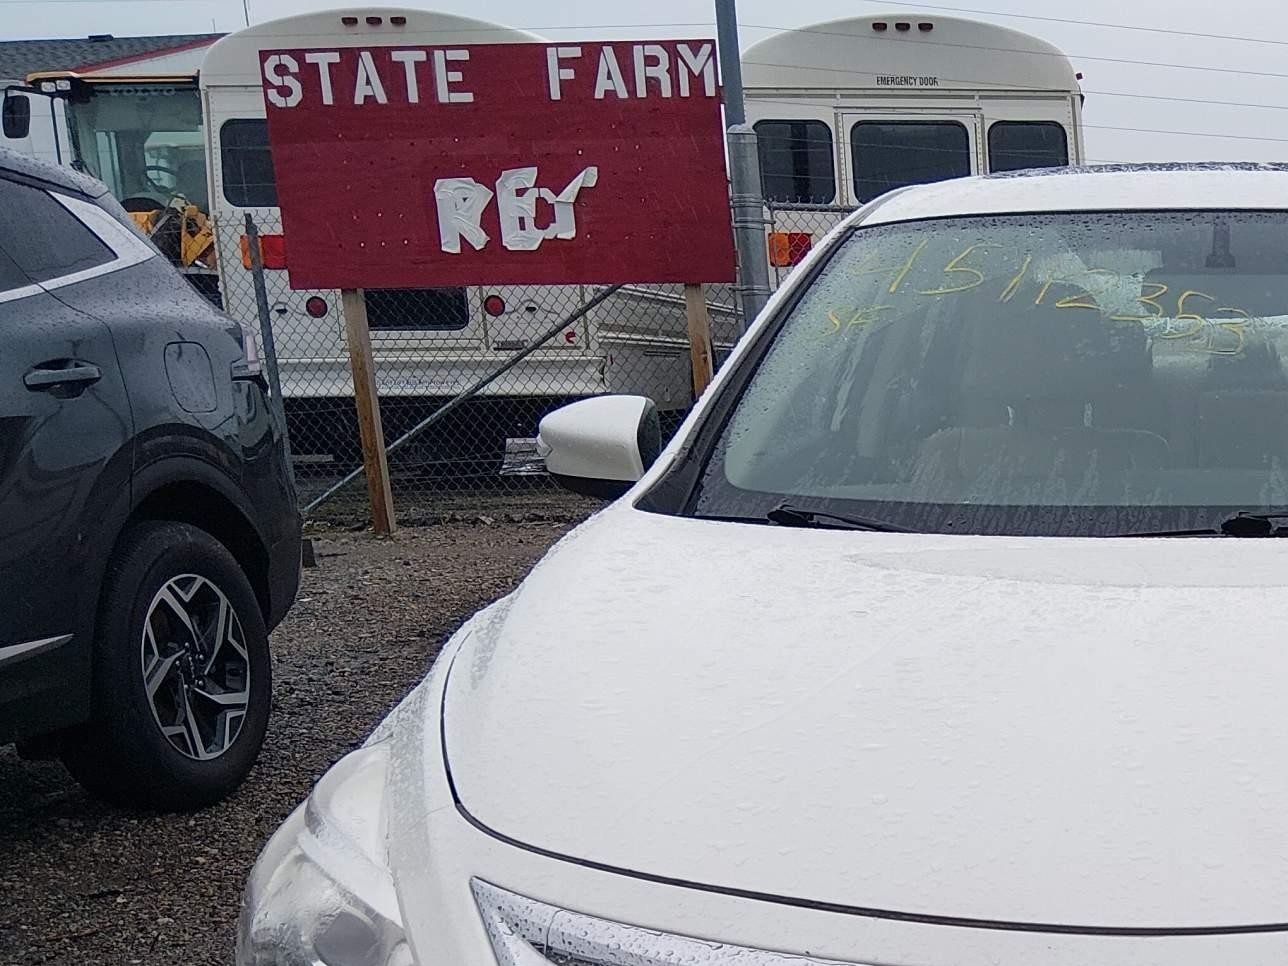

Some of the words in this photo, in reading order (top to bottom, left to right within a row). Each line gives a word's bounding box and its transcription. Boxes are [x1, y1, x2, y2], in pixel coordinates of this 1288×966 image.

[263, 49, 475, 108] STATE
[546, 42, 717, 100] FARM
[876, 76, 917, 86] EMERGENCY
[919, 76, 939, 87] DOOR
